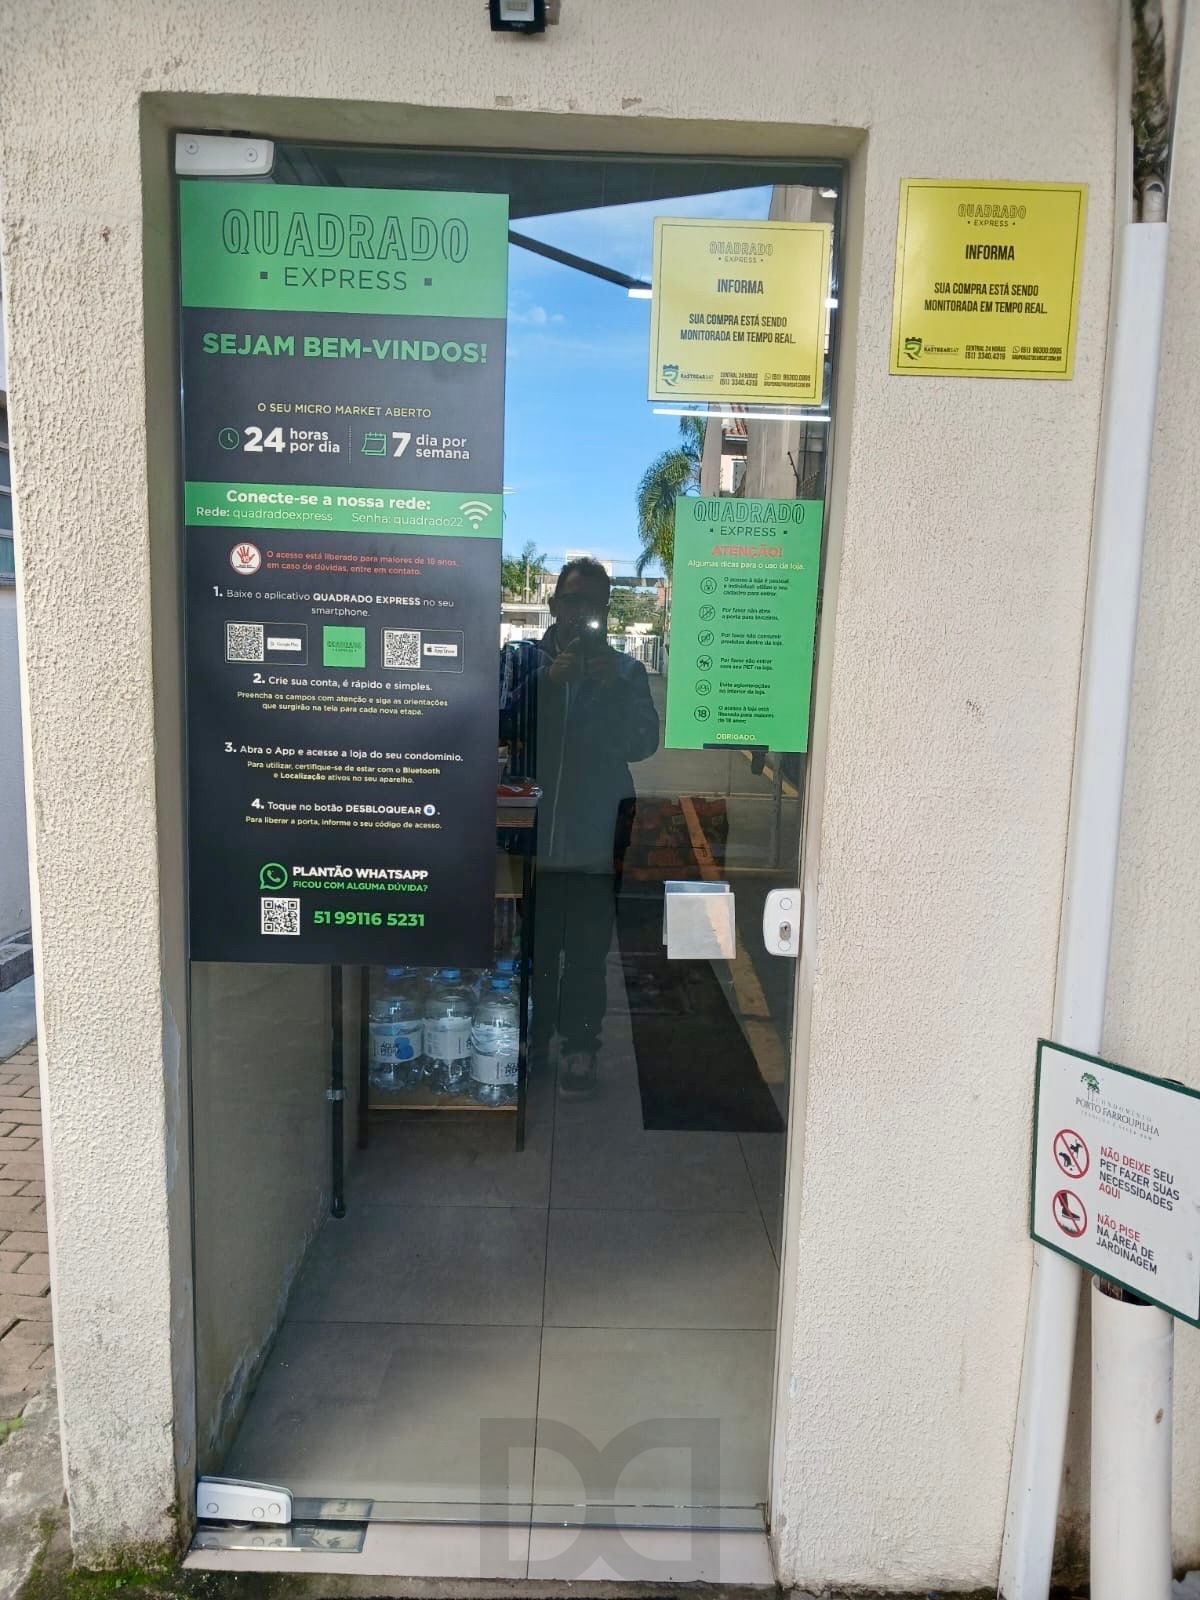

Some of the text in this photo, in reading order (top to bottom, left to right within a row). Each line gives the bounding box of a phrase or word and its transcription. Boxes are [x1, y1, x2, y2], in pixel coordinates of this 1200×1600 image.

[958, 204, 1026, 219] QUADRADO
[222, 208, 469, 264] QUADRADO
[710, 241, 773, 256] QUADRADO
[966, 245, 1014, 260] INFORMA
[283, 267, 407, 290] EXPRESS
[717, 279, 763, 294] INFORMA
[934, 283, 1038, 296] SUA COMPRA ESTÁ SENDO
[925, 300, 1047, 314] MONITORADA EM TEMPO REAL.
[689, 314, 787, 327] SUA COMPRA ESTÁ SENDO
[681, 330, 796, 344] MONITORADA EM TEMPO REAL.
[203, 333, 487, 363] SEJAM BEM-VINDOS!
[257, 403, 431, 418] O SEU MICRO MARKET ABERTO
[243, 427, 286, 452] 24
[290, 428, 329, 441] horas
[416, 435, 467, 449] dia por
[290, 442, 340, 454] por dia
[392, 432, 411, 457] 7
[416, 448, 470, 460] semana
[226, 490, 431, 510] Conecte-se a nossa rede:
[196, 507, 464, 527] Rede: quadradoexpress Senha: quadrado22
[694, 501, 804, 524] QUADRADO
[721, 527, 776, 536] EXPRESS
[712, 544, 782, 559] ATENÇÃO!
[688, 560, 718, 568] Algumas
[213, 586, 223, 597] 1.
[226, 590, 253, 598] Baixe
[264, 592, 310, 601] aplicativo
[313, 593, 373, 604] QUADRADO
[376, 596, 421, 606] EXPRESS
[312, 607, 370, 617] smartphone.
[253, 673, 265, 684] 2.
[269, 676, 288, 685] Crie
[291, 678, 307, 686] sua
[310, 679, 340, 688] conta,
[343, 679, 348, 687] é
[352, 679, 383, 690] rápido
[394, 681, 433, 691] simples.
[286, 694, 315, 702] campos
[336, 695, 366, 704] atenção
[376, 697, 391, 705] siga
[404, 699, 448, 707] orientações
[225, 742, 237, 752] 3.
[240, 745, 263, 754] Abra
[275, 746, 295, 757] App
[306, 749, 338, 757] acesse
[350, 750, 367, 760] loja
[370, 750, 383, 758] do
[404, 752, 463, 761] condomínio.
[266, 762, 293, 770] utilizar,
[295, 763, 342, 771] certifique-se
[281, 772, 325, 782] Localização
[379, 776, 414, 784] aparelho.
[252, 798, 264, 809] 4.
[268, 802, 296, 812] Toque
[315, 803, 343, 812] botão
[346, 805, 421, 814] DESBLOQUEAR
[375, 820, 401, 829] código
[293, 865, 428, 880] PLANTÃO WHATSAPP
[293, 881, 321, 889] FICOU
[347, 882, 385, 891] ALGUMA
[388, 882, 428, 892] DÚVIDA?
[314, 911, 424, 926] 51 99116 5231
[1076, 1097, 1101, 1113] PORTO
[1103, 1108, 1159, 1136] FARROUPILHA
[1101, 1146, 1174, 1184] NÃO DEIXE SEU
[1100, 1159, 1179, 1200] PET FAZER SUAS
[1099, 1183, 1120, 1199] AQUI
[1100, 1171, 1173, 1211] NECESSIDADES
[1098, 1214, 1141, 1243] NÃO PISE
[1097, 1225, 1154, 1260] NA ÁREA DE
[1096, 1237, 1158, 1275] JARDINAGEM
